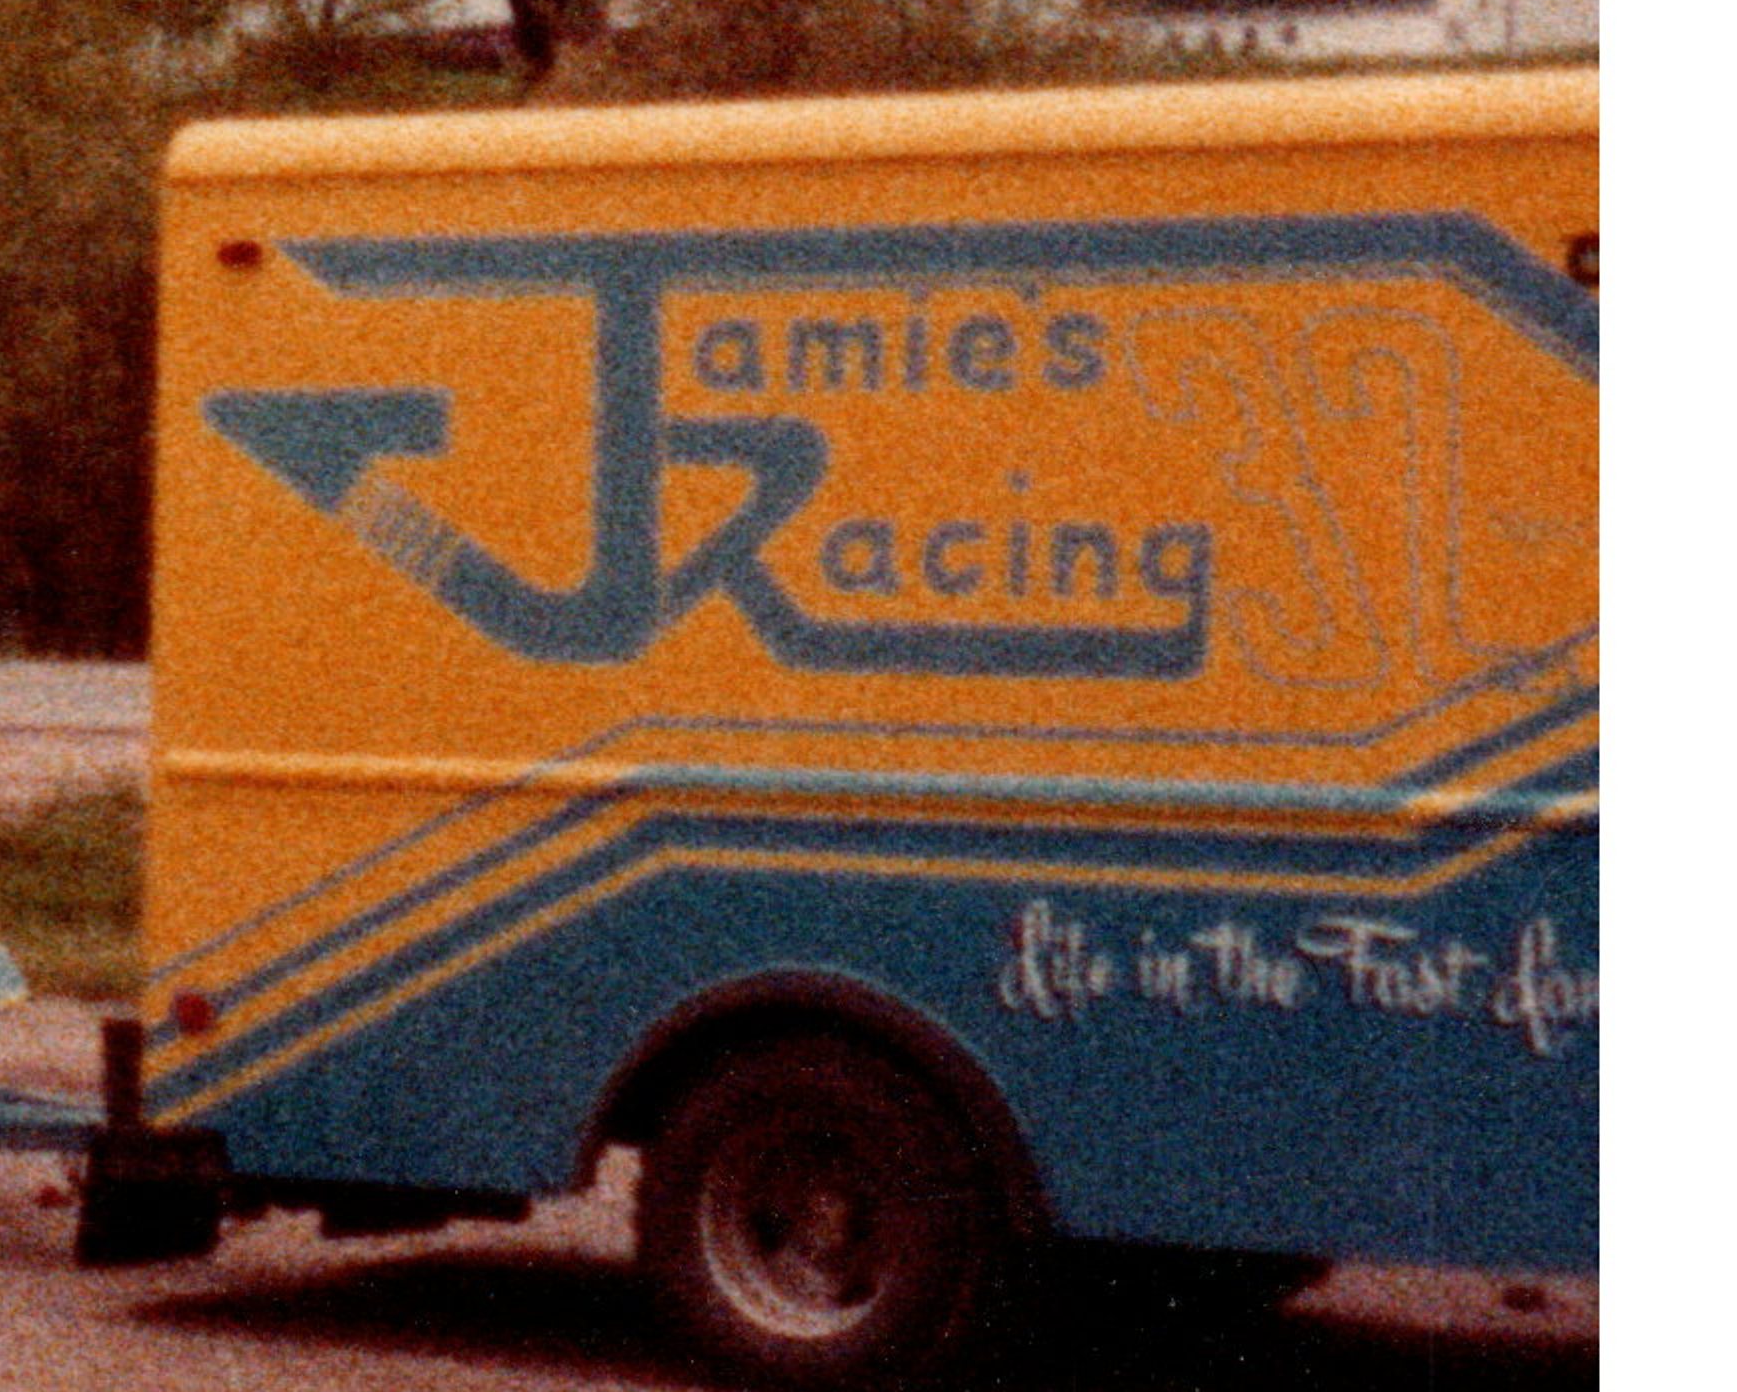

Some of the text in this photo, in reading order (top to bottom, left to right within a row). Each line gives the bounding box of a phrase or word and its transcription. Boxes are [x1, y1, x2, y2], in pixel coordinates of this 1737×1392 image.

[657, 414, 1215, 680] Racing
[1138, 928, 1195, 1010] in
[1192, 919, 1300, 1009] the
[1296, 914, 1487, 1013] Fast
